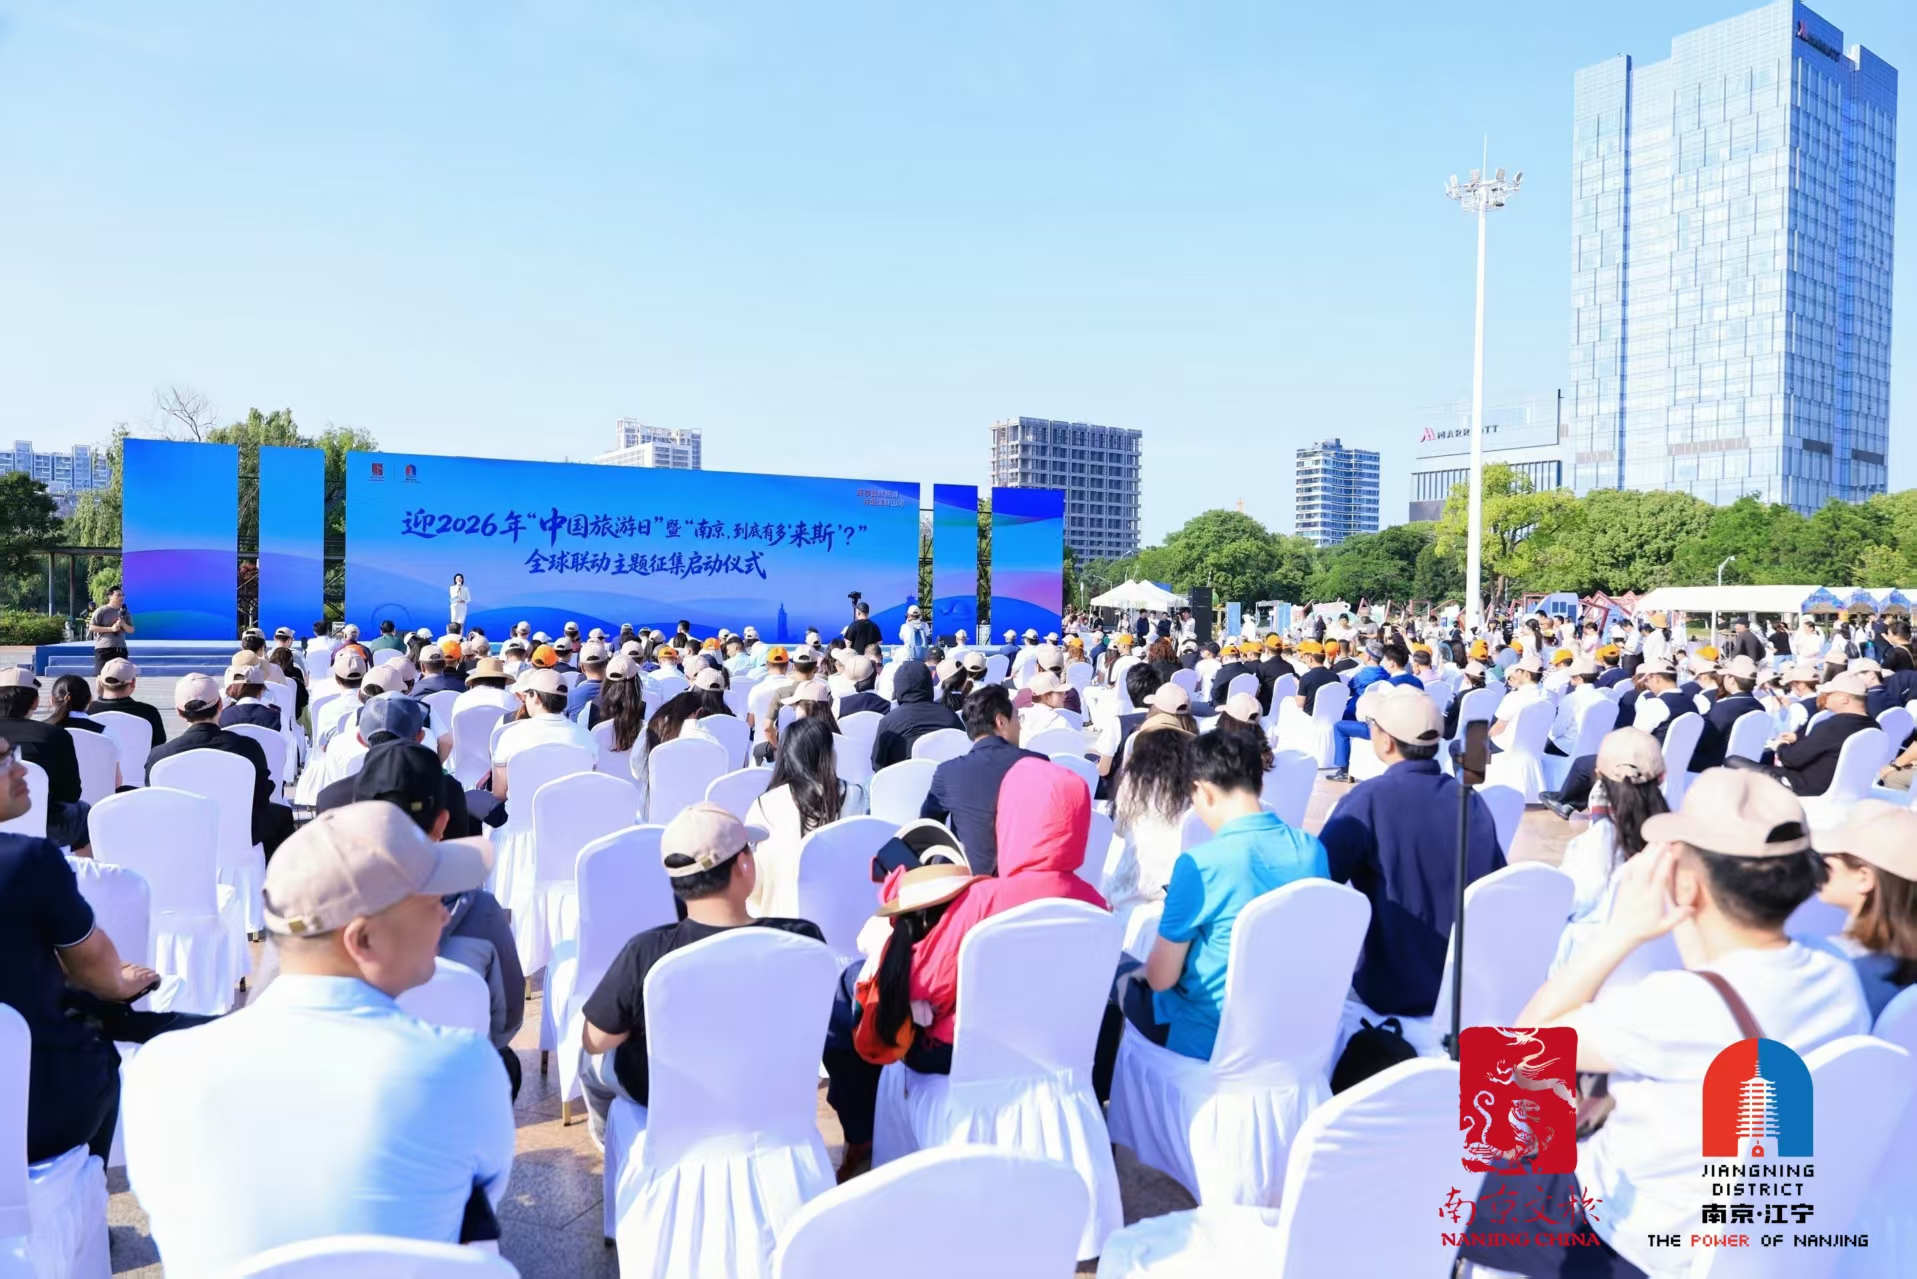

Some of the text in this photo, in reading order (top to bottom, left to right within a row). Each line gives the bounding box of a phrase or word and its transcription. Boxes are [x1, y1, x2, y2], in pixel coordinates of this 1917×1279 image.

[1437, 424, 1499, 440] MARRTT
[524, 548, 767, 580] 全球联动主题征集启动仪式
